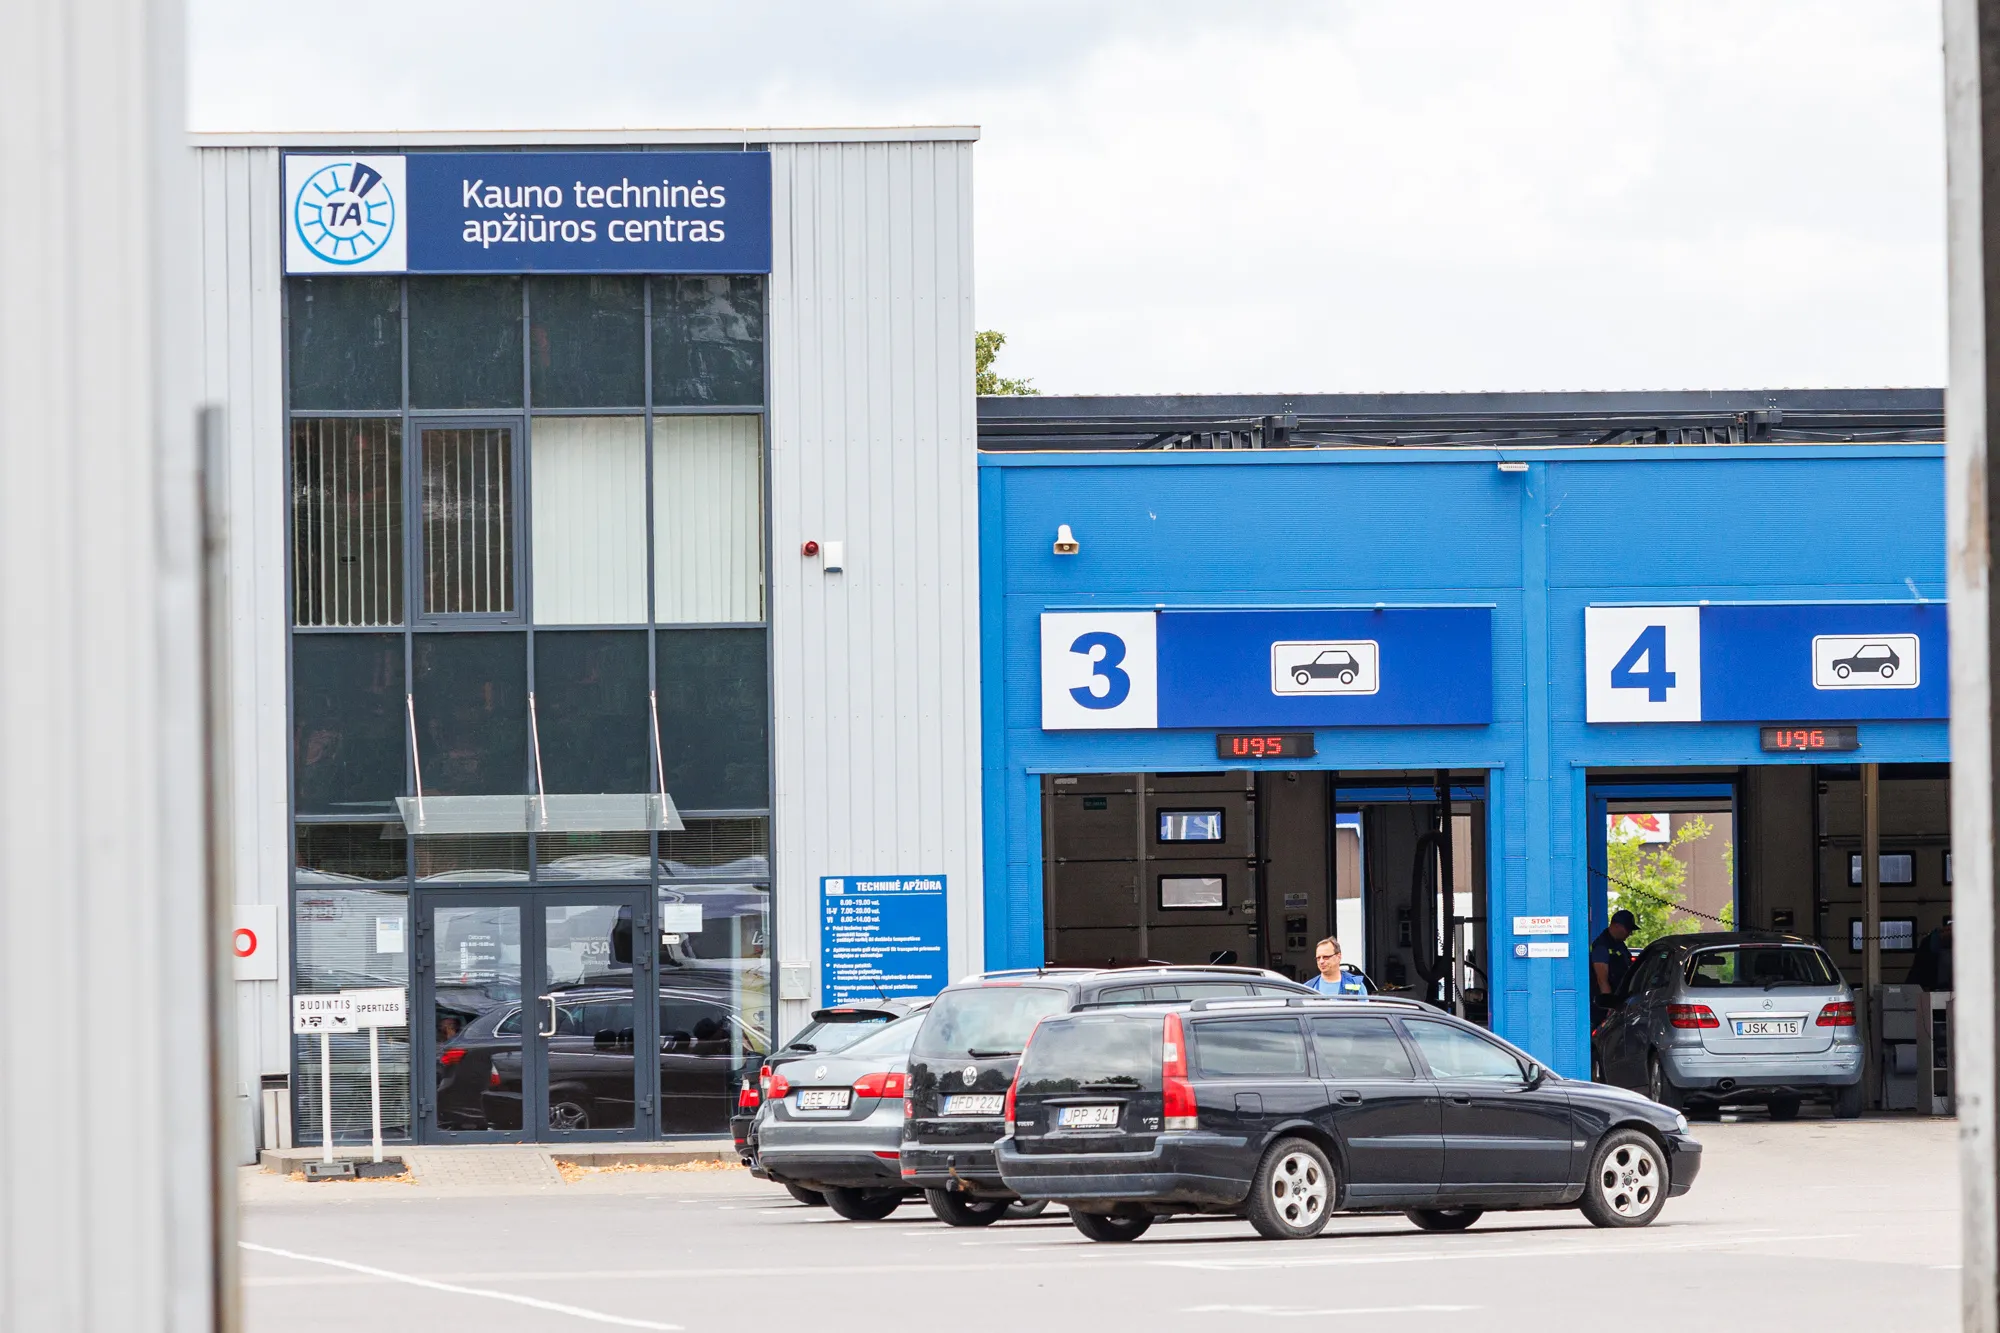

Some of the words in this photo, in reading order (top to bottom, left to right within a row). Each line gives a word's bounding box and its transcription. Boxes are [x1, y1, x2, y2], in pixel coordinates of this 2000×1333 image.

[462, 179, 563, 208] Kauno
[573, 177, 726, 208] techninės
[327, 202, 362, 227] TA
[462, 213, 598, 249] apžiūros
[607, 216, 725, 243] centras
[1069, 631, 1131, 710] 3
[1611, 625, 1676, 702] 4
[1232, 737, 1283, 755] U95
[1776, 730, 1825, 748] U96
[856, 880, 901, 892] TECHNINĖ
[902, 879, 942, 891] APŽIŪRA
[300, 999, 351, 1010] BUDINTIS
[1744, 1022, 1769, 1034] JSK
[1777, 1022, 1797, 1033] 115
[803, 1092, 824, 1105] GEE
[829, 1092, 848, 1105] 714
[950, 1096, 974, 1110] HFD
[979, 1096, 1001, 1109] 224
[1065, 1108, 1089, 1123] JPP
[1094, 1108, 1116, 1123] 341
